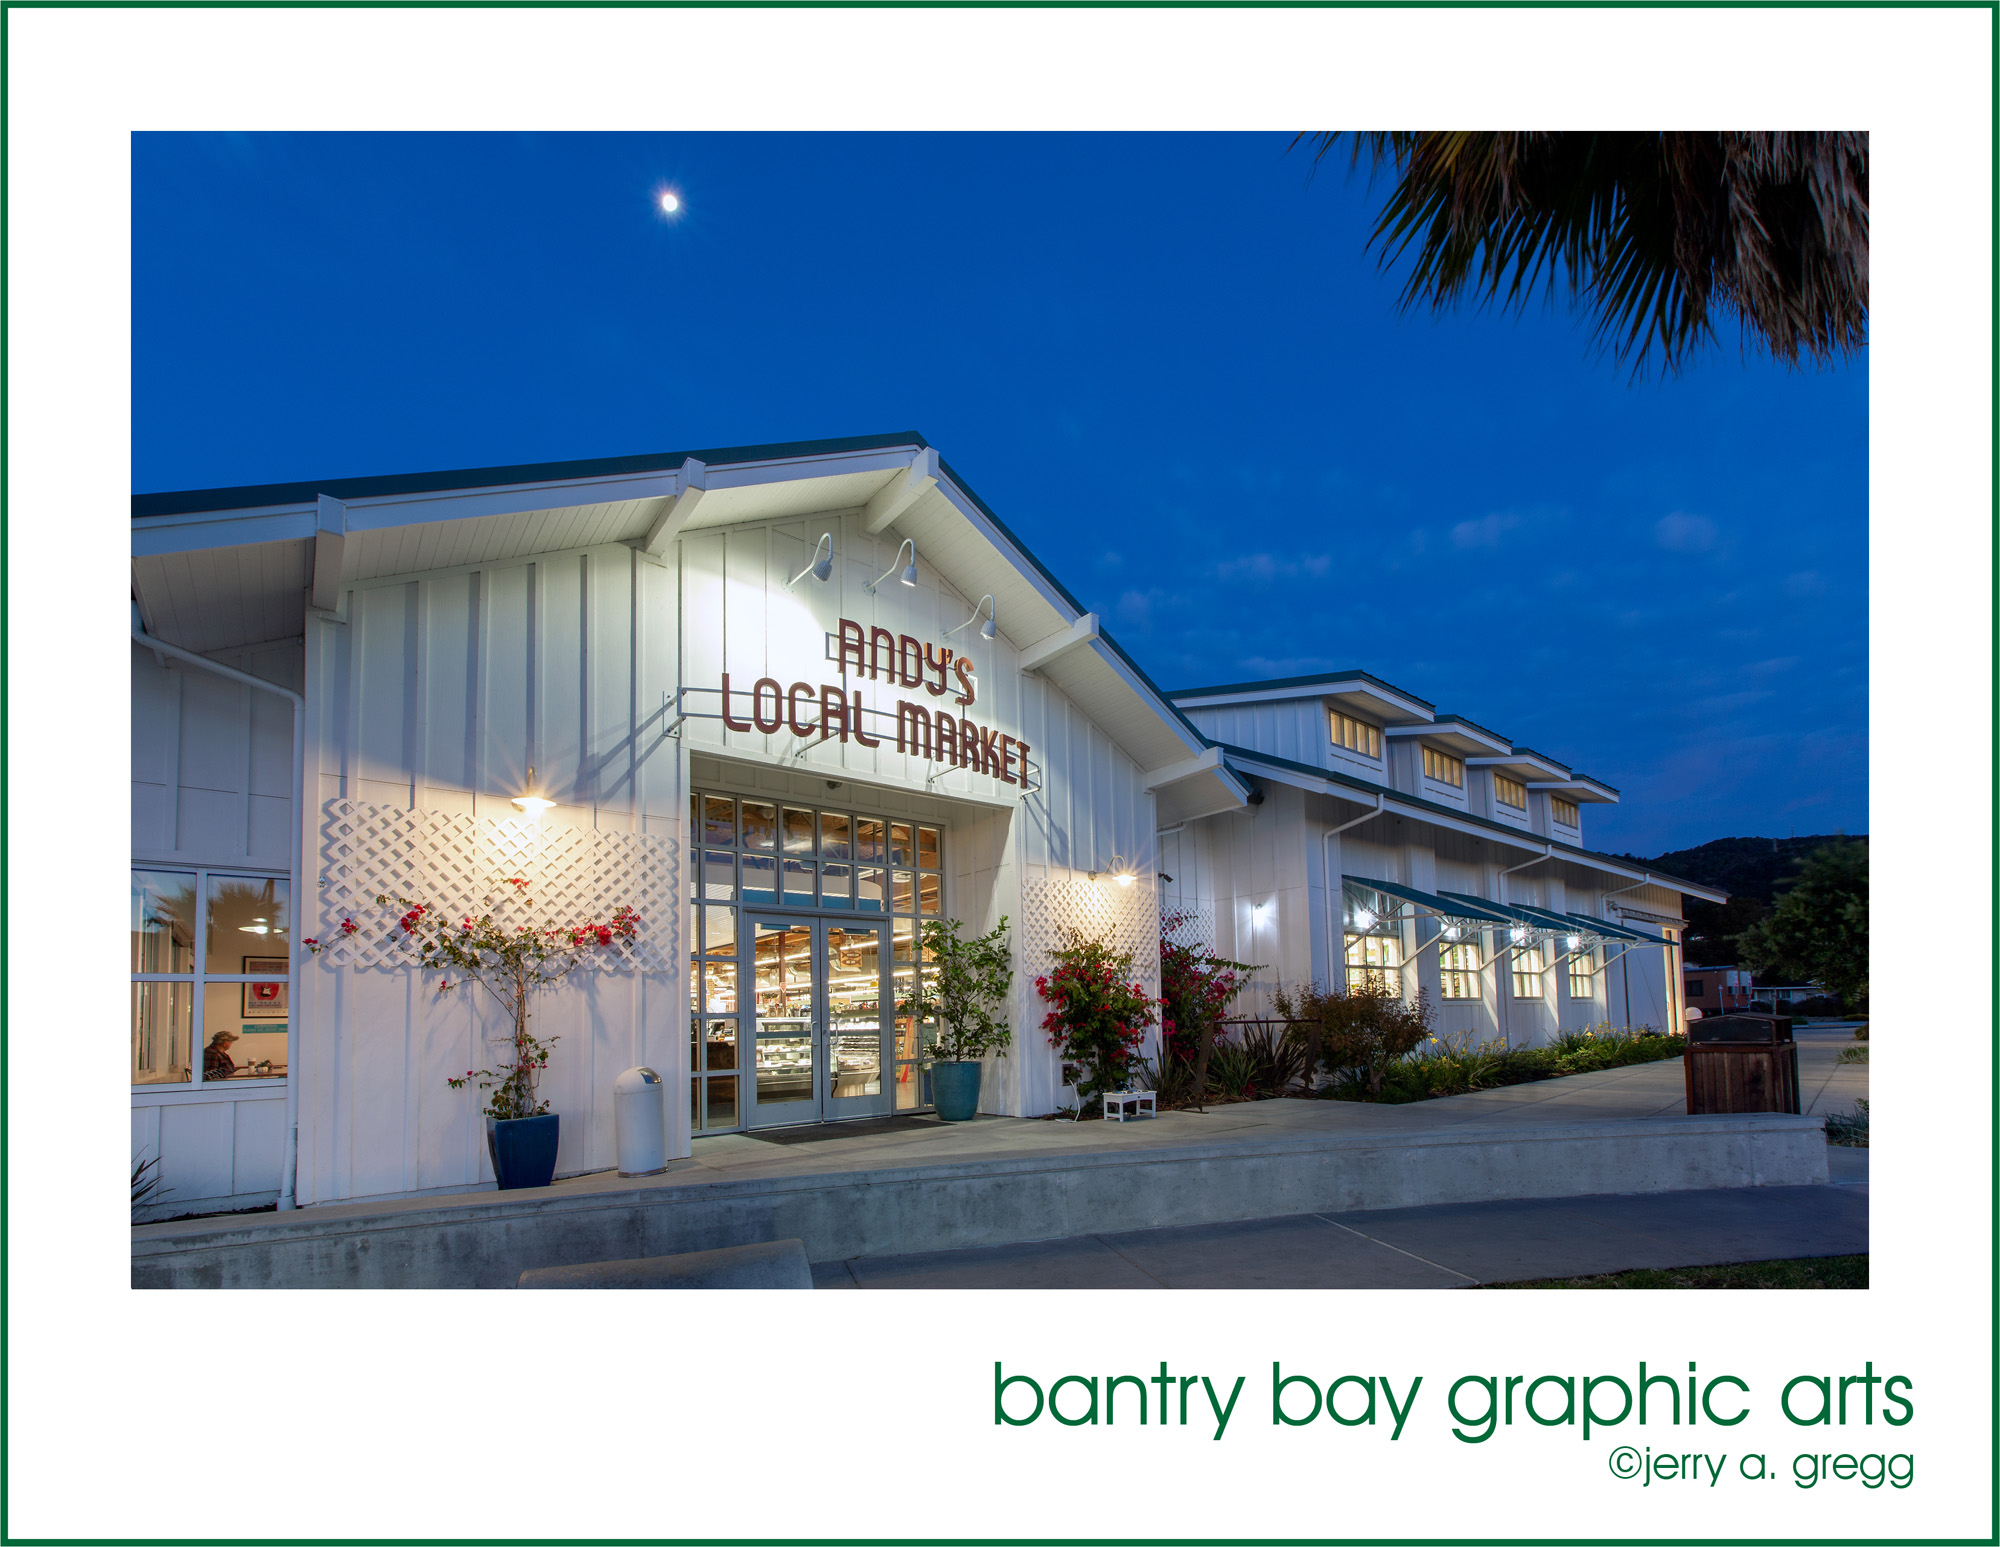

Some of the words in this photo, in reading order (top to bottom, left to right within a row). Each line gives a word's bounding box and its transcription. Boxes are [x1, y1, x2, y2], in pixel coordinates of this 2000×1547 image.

[837, 618, 976, 706] ANDY'S
[722, 673, 880, 748] LOCAL
[896, 700, 1031, 789] MARKET
